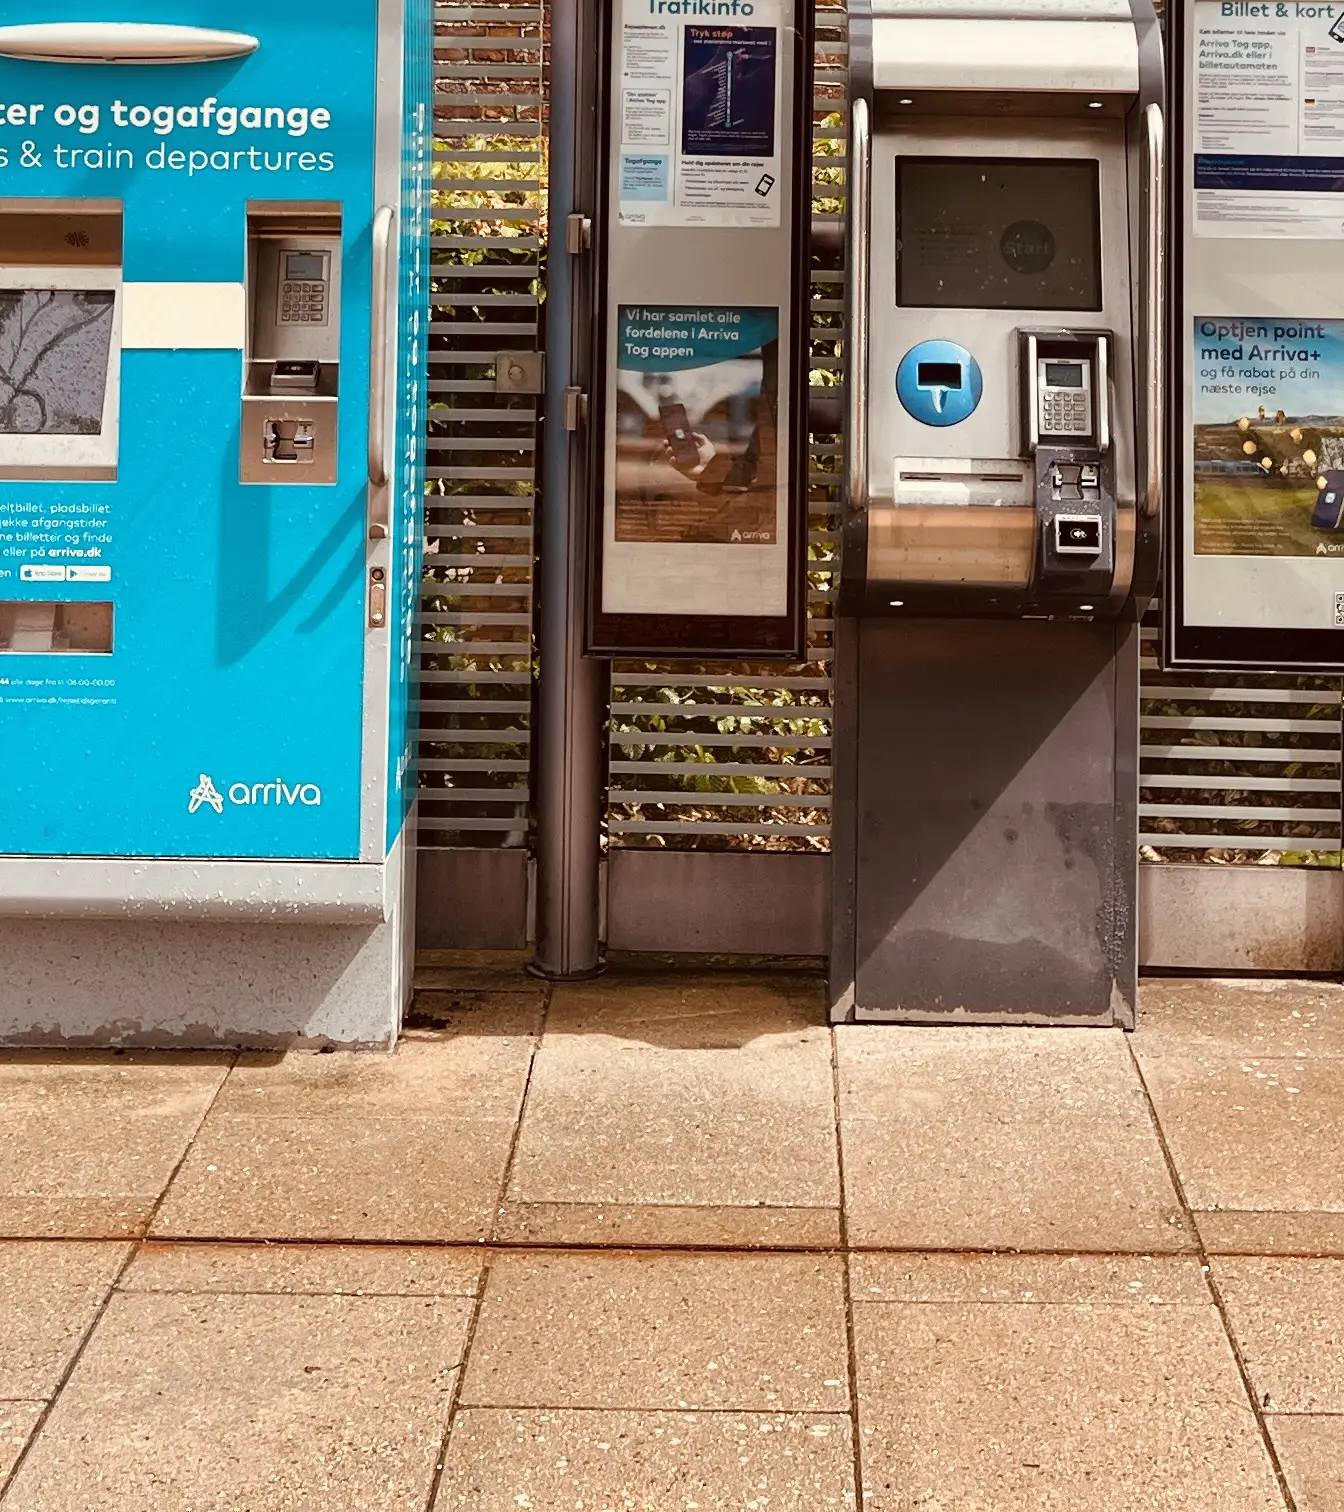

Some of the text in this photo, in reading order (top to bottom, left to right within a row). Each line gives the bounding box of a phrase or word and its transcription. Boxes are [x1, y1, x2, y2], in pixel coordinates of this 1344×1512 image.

[1221, 2, 1334, 18] Billet & kort
[691, 29, 733, 40] Tryk stop
[1199, 40, 1273, 50] Arriva Tog app,
[1199, 50, 1243, 58] Arriva.dk
[1246, 51, 1267, 59] eller
[1199, 61, 1278, 70] billetautomaten
[54, 103, 100, 134] og
[113, 97, 330, 137] togafgange
[20, 141, 42, 168] &
[53, 142, 133, 169] train
[146, 142, 334, 176] departures
[627, 310, 740, 323] Vi har samlet alle
[626, 327, 688, 340] fordelene
[698, 329, 739, 340] Arriva
[1201, 322, 1325, 341] Optjen point
[626, 344, 694, 358] Tog appen
[1201, 345, 1321, 361] med Arriva+
[1201, 367, 1319, 380] og få rabat på din
[1201, 384, 1276, 396] næste rejse
[16, 532, 62, 543] billetter
[64, 535, 79, 544] og
[83, 532, 112, 544] finde
[3, 547, 26, 558] eller
[30, 548, 46, 558] på
[48, 546, 102, 558] arriva.dk
[229, 778, 320, 806] arriva
